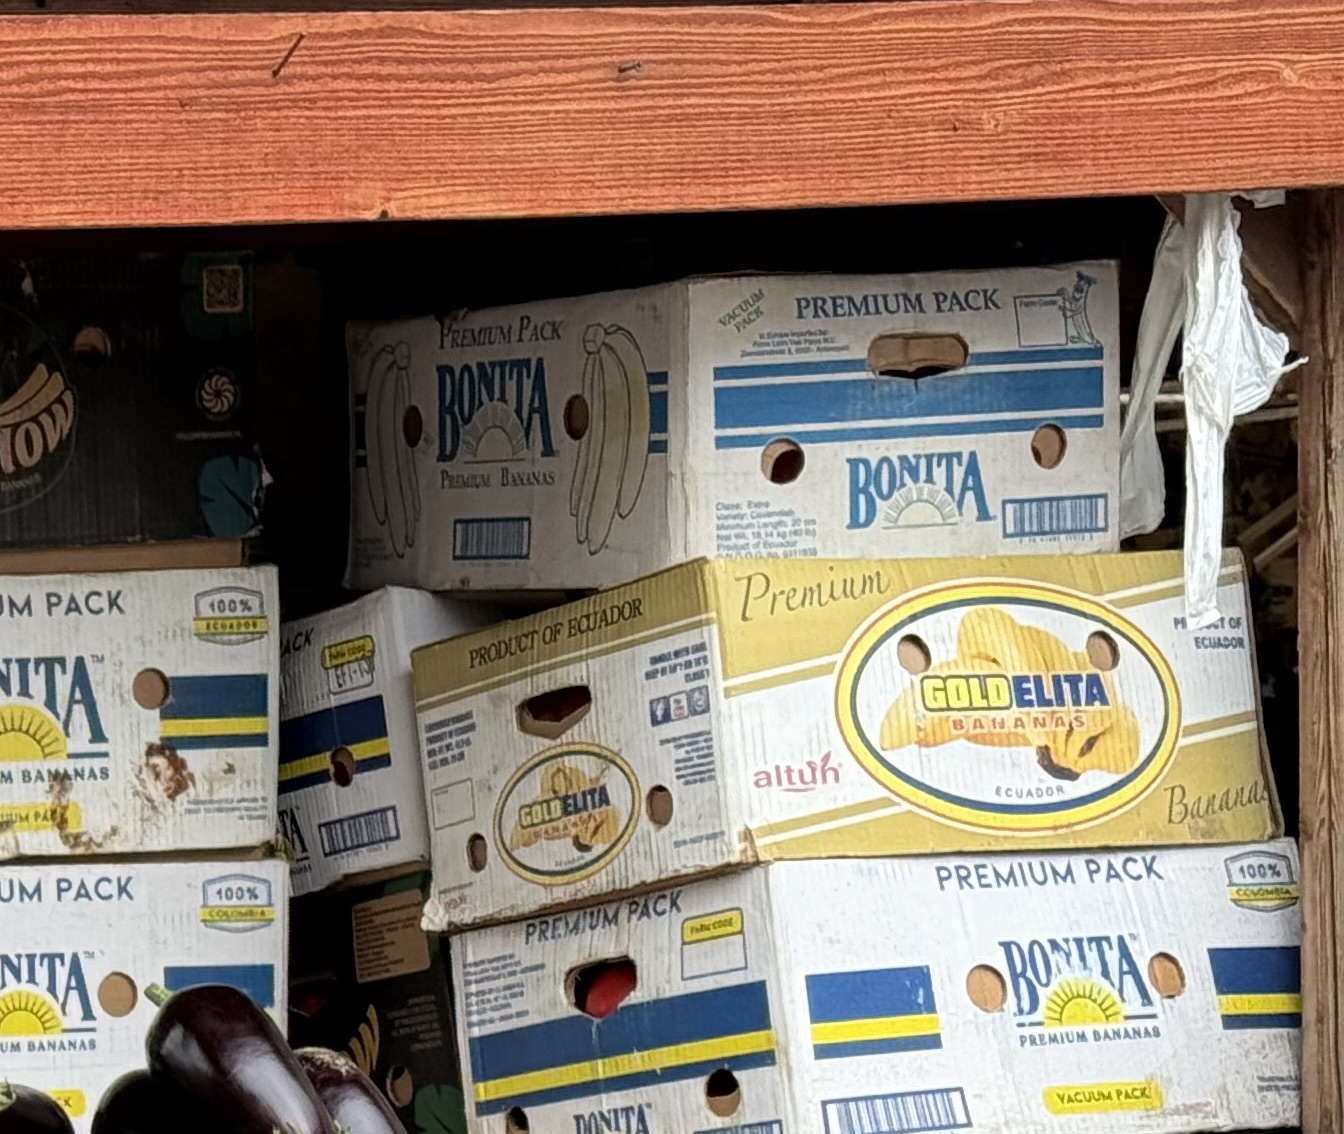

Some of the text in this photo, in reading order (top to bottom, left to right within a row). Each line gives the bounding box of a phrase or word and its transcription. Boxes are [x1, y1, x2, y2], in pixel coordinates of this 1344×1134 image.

[718, 288, 766, 328] VACUUM
[795, 288, 1002, 319] PREMIUM PACK
[439, 314, 564, 349] PREMIUM PACK
[733, 306, 765, 334] PACK
[435, 357, 557, 462] BONITA
[440, 466, 556, 489] PREMIUM BANANAS
[845, 450, 993, 530] BONITA
[46, 590, 126, 616] PACK
[209, 599, 252, 614] 100%
[735, 565, 889, 623] Premium
[468, 597, 643, 669] PRODUCT OF ECUADOR
[1228, 616, 1242, 630] OF
[280, 627, 315, 656] ACK
[1194, 636, 1245, 650] ECUADOR
[952, 715, 1086, 731] BANANAS
[21, 766, 111, 785] BANANAS
[995, 785, 1066, 799] ECUADOR
[936, 854, 1164, 891] PREMIUM PACK
[1238, 862, 1281, 880] 100%
[56, 876, 134, 901] PACK
[215, 886, 259, 902] 100%
[524, 889, 683, 946] PREMIUM PACK
[998, 934, 1154, 1017] BONITA
[27, 1038, 97, 1053] BANANAS
[1018, 1025, 1162, 1048] PREMIUM BANANAS
[1055, 1085, 1150, 1105] VACUUM PACK
